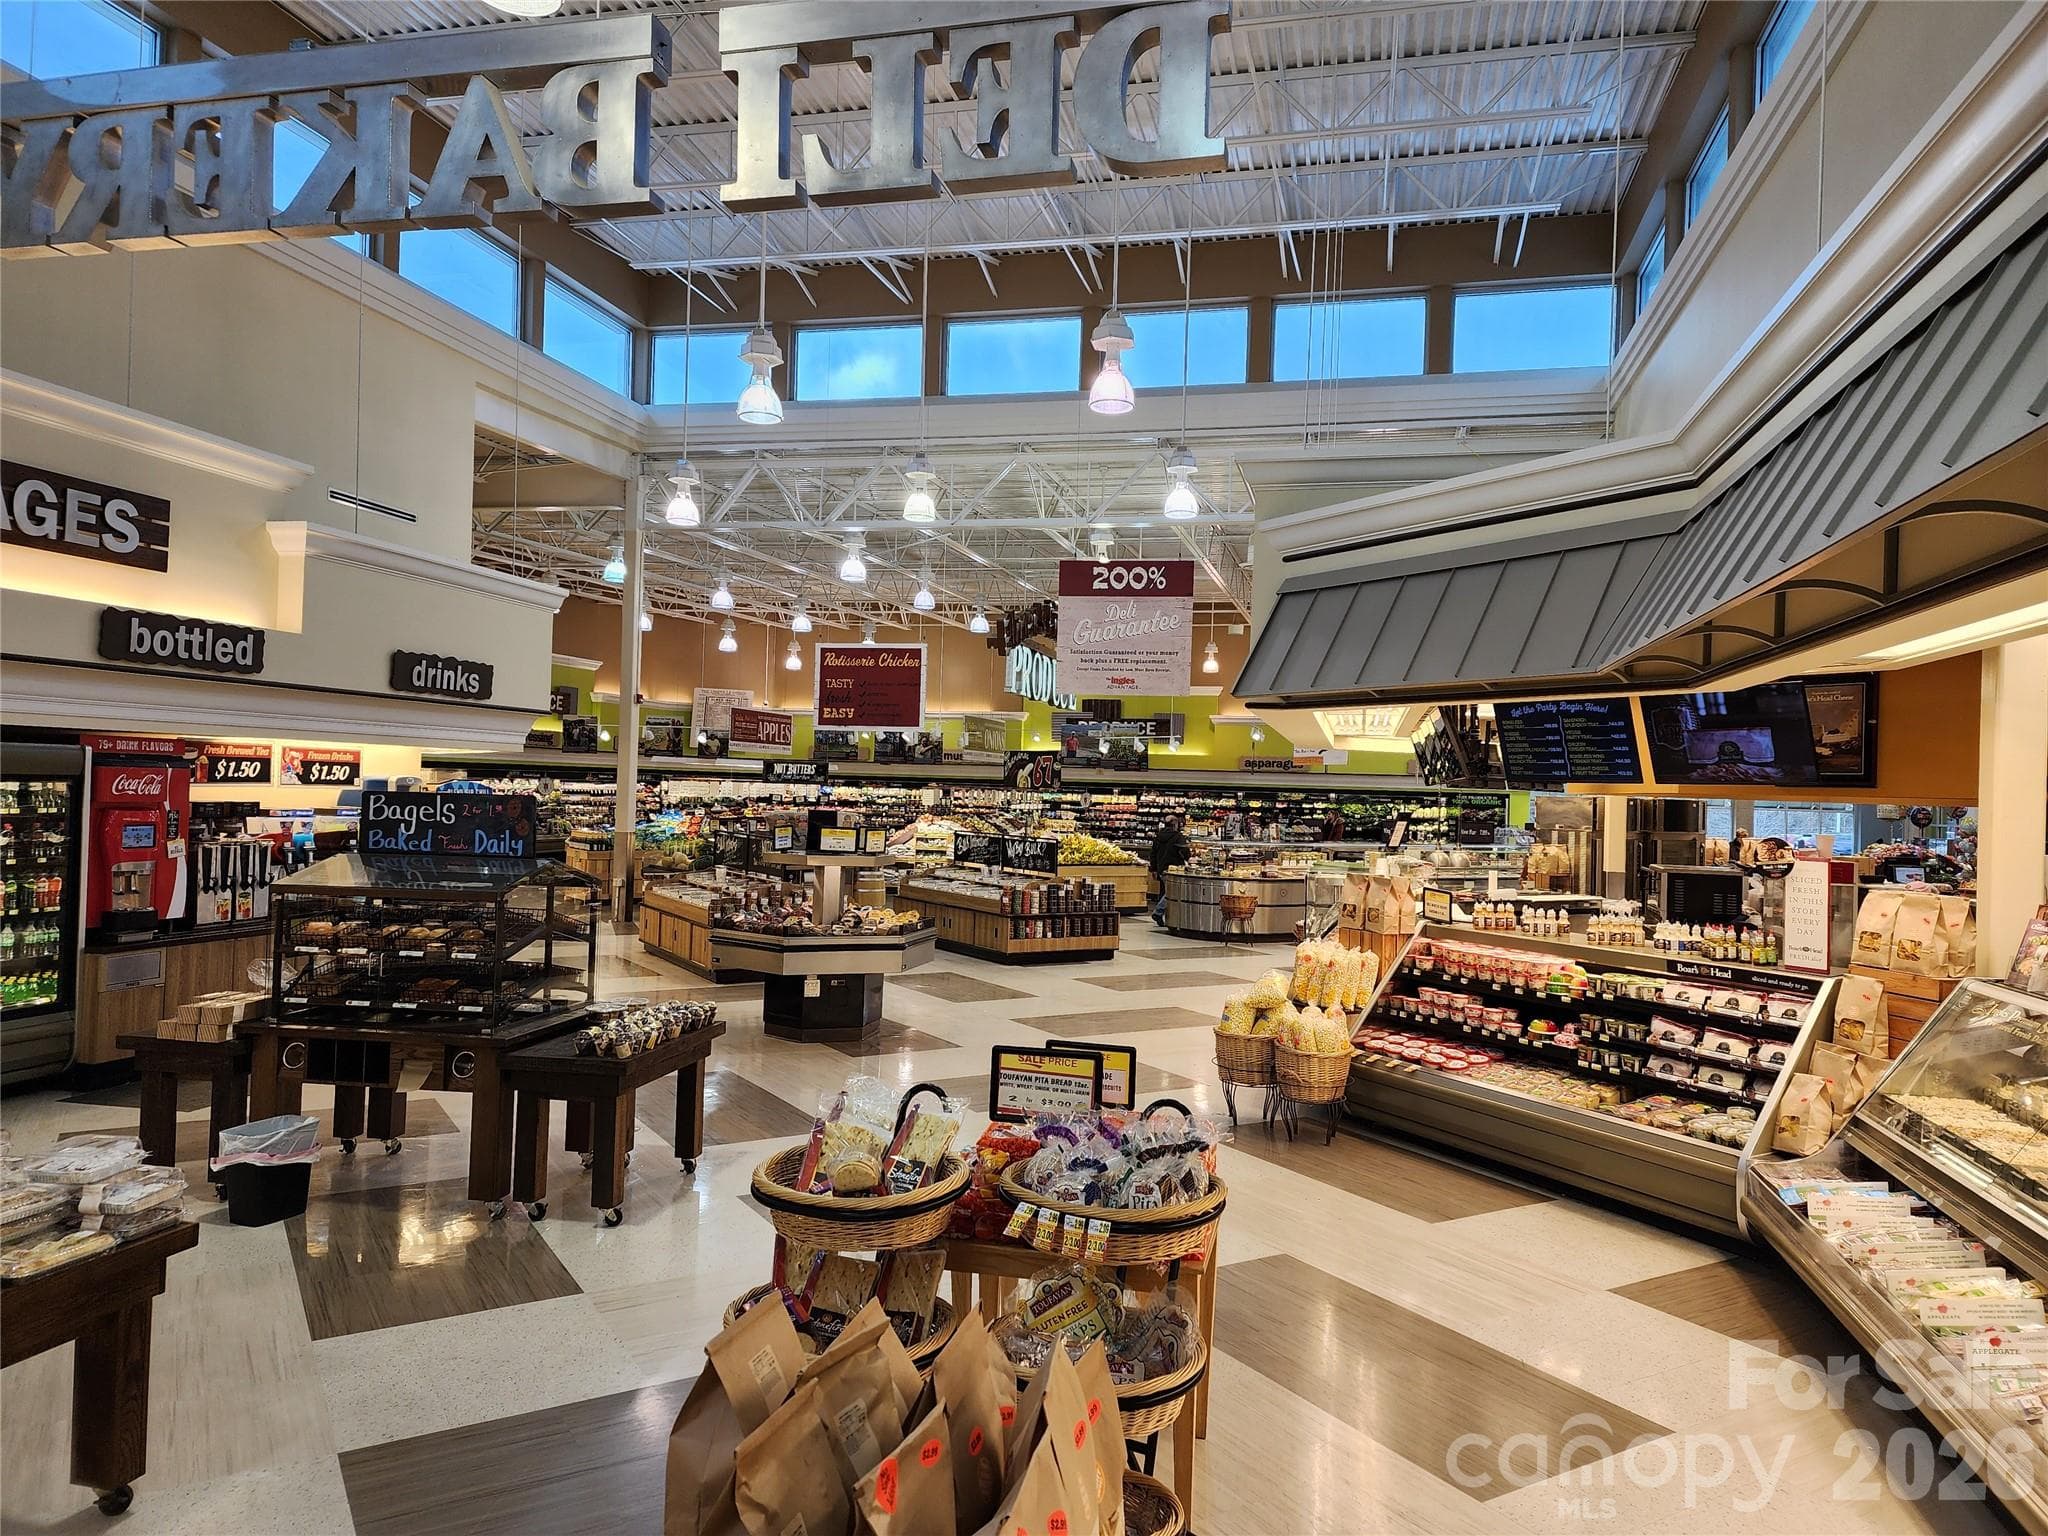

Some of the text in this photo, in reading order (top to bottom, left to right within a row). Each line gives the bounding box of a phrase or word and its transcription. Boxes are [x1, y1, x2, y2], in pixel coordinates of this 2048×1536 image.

[1092, 565, 1167, 590] 200%
[1104, 600, 1137, 623] Deli
[1073, 610, 1182, 645] Guarantee
[129, 617, 254, 667] bottled
[823, 652, 876, 667] Rotisserie
[412, 659, 480, 694] drinks
[825, 679, 855, 689] TASTY
[1008, 645, 1077, 711] PRODU
[823, 707, 855, 719] EASY
[1535, 703, 1558, 714] Party
[1559, 701, 1583, 714] Begin
[1584, 703, 1609, 714] Here!
[758, 721, 791, 744] APPLES
[98, 738, 174, 753] 79+ DRINK FLAVORS
[203, 744, 270, 756] Fresh Brewed Tea
[307, 751, 354, 762] Frozen Drinks
[214, 760, 262, 779] $1.50
[309, 765, 350, 781] $1.50
[1033, 755, 1054, 787] 67
[111, 773, 165, 796] Coca-Cola
[368, 795, 457, 835] Bagels
[462, 803, 471, 817] 2
[368, 828, 432, 852] Baked
[474, 829, 523, 857] Daily
[1790, 877, 1823, 885] SLICED
[1792, 886, 1820, 895] FRESH
[1791, 906, 1820, 916] STORE
[1791, 917, 1820, 926] EVERY
[1796, 928, 1815, 936] DAY
[1676, 963, 1732, 979] Boar's Head
[1751, 975, 1768, 984] sliced
[1768, 977, 1778, 985] and
[1778, 980, 1795, 990] ready
[1018, 1054, 1079, 1068] SALE PRICE
[1000, 1072, 1033, 1083] TOUFAYAN
[1034, 1075, 1049, 1084] PITA
[1050, 1077, 1073, 1087] BREAD
[1008, 1094, 1018, 1102] 2
[1040, 1098, 1072, 1108] $3.00
[1032, 1284, 1074, 1314] TOUFAYAN
[1065, 1300, 1089, 1320] FREE
